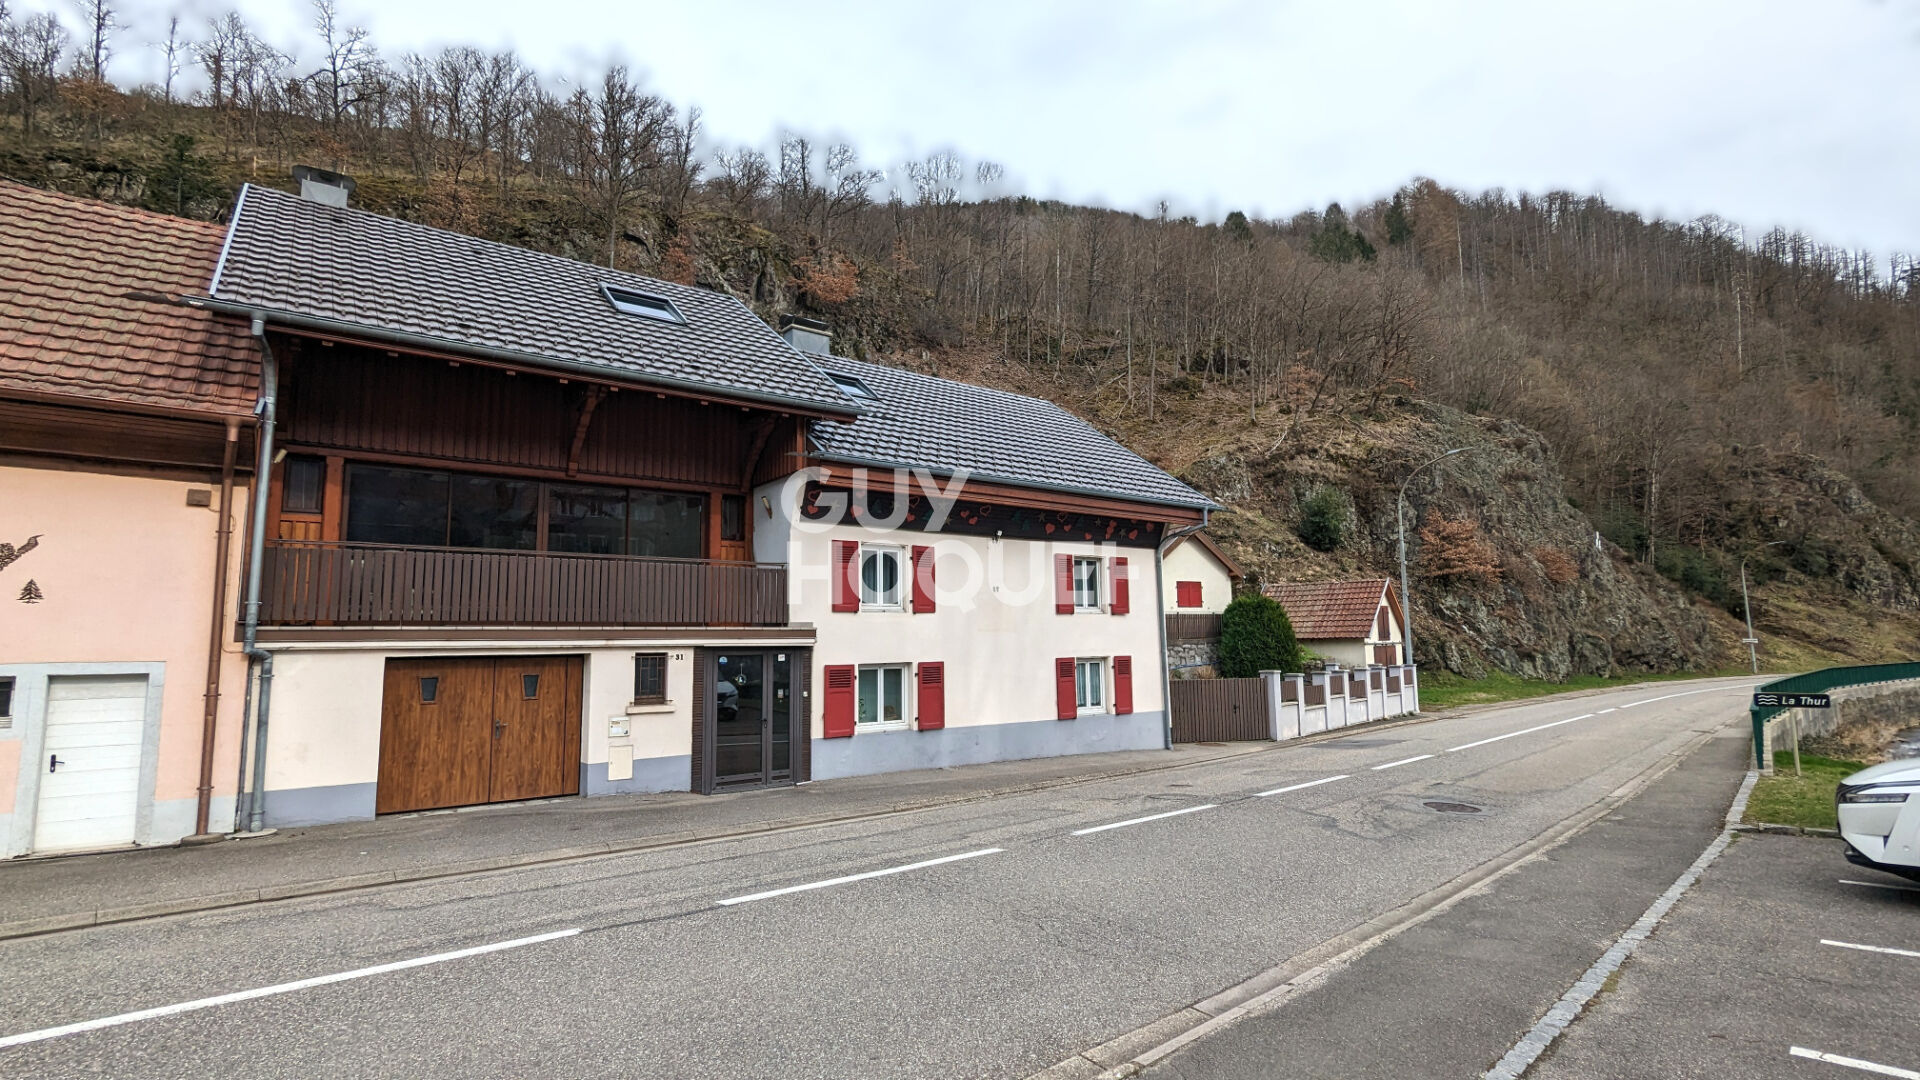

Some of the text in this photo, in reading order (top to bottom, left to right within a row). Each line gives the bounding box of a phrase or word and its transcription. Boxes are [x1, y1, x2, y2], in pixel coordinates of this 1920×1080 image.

[675, 653, 684, 661] 31
[1781, 696, 1827, 706] La Thur
